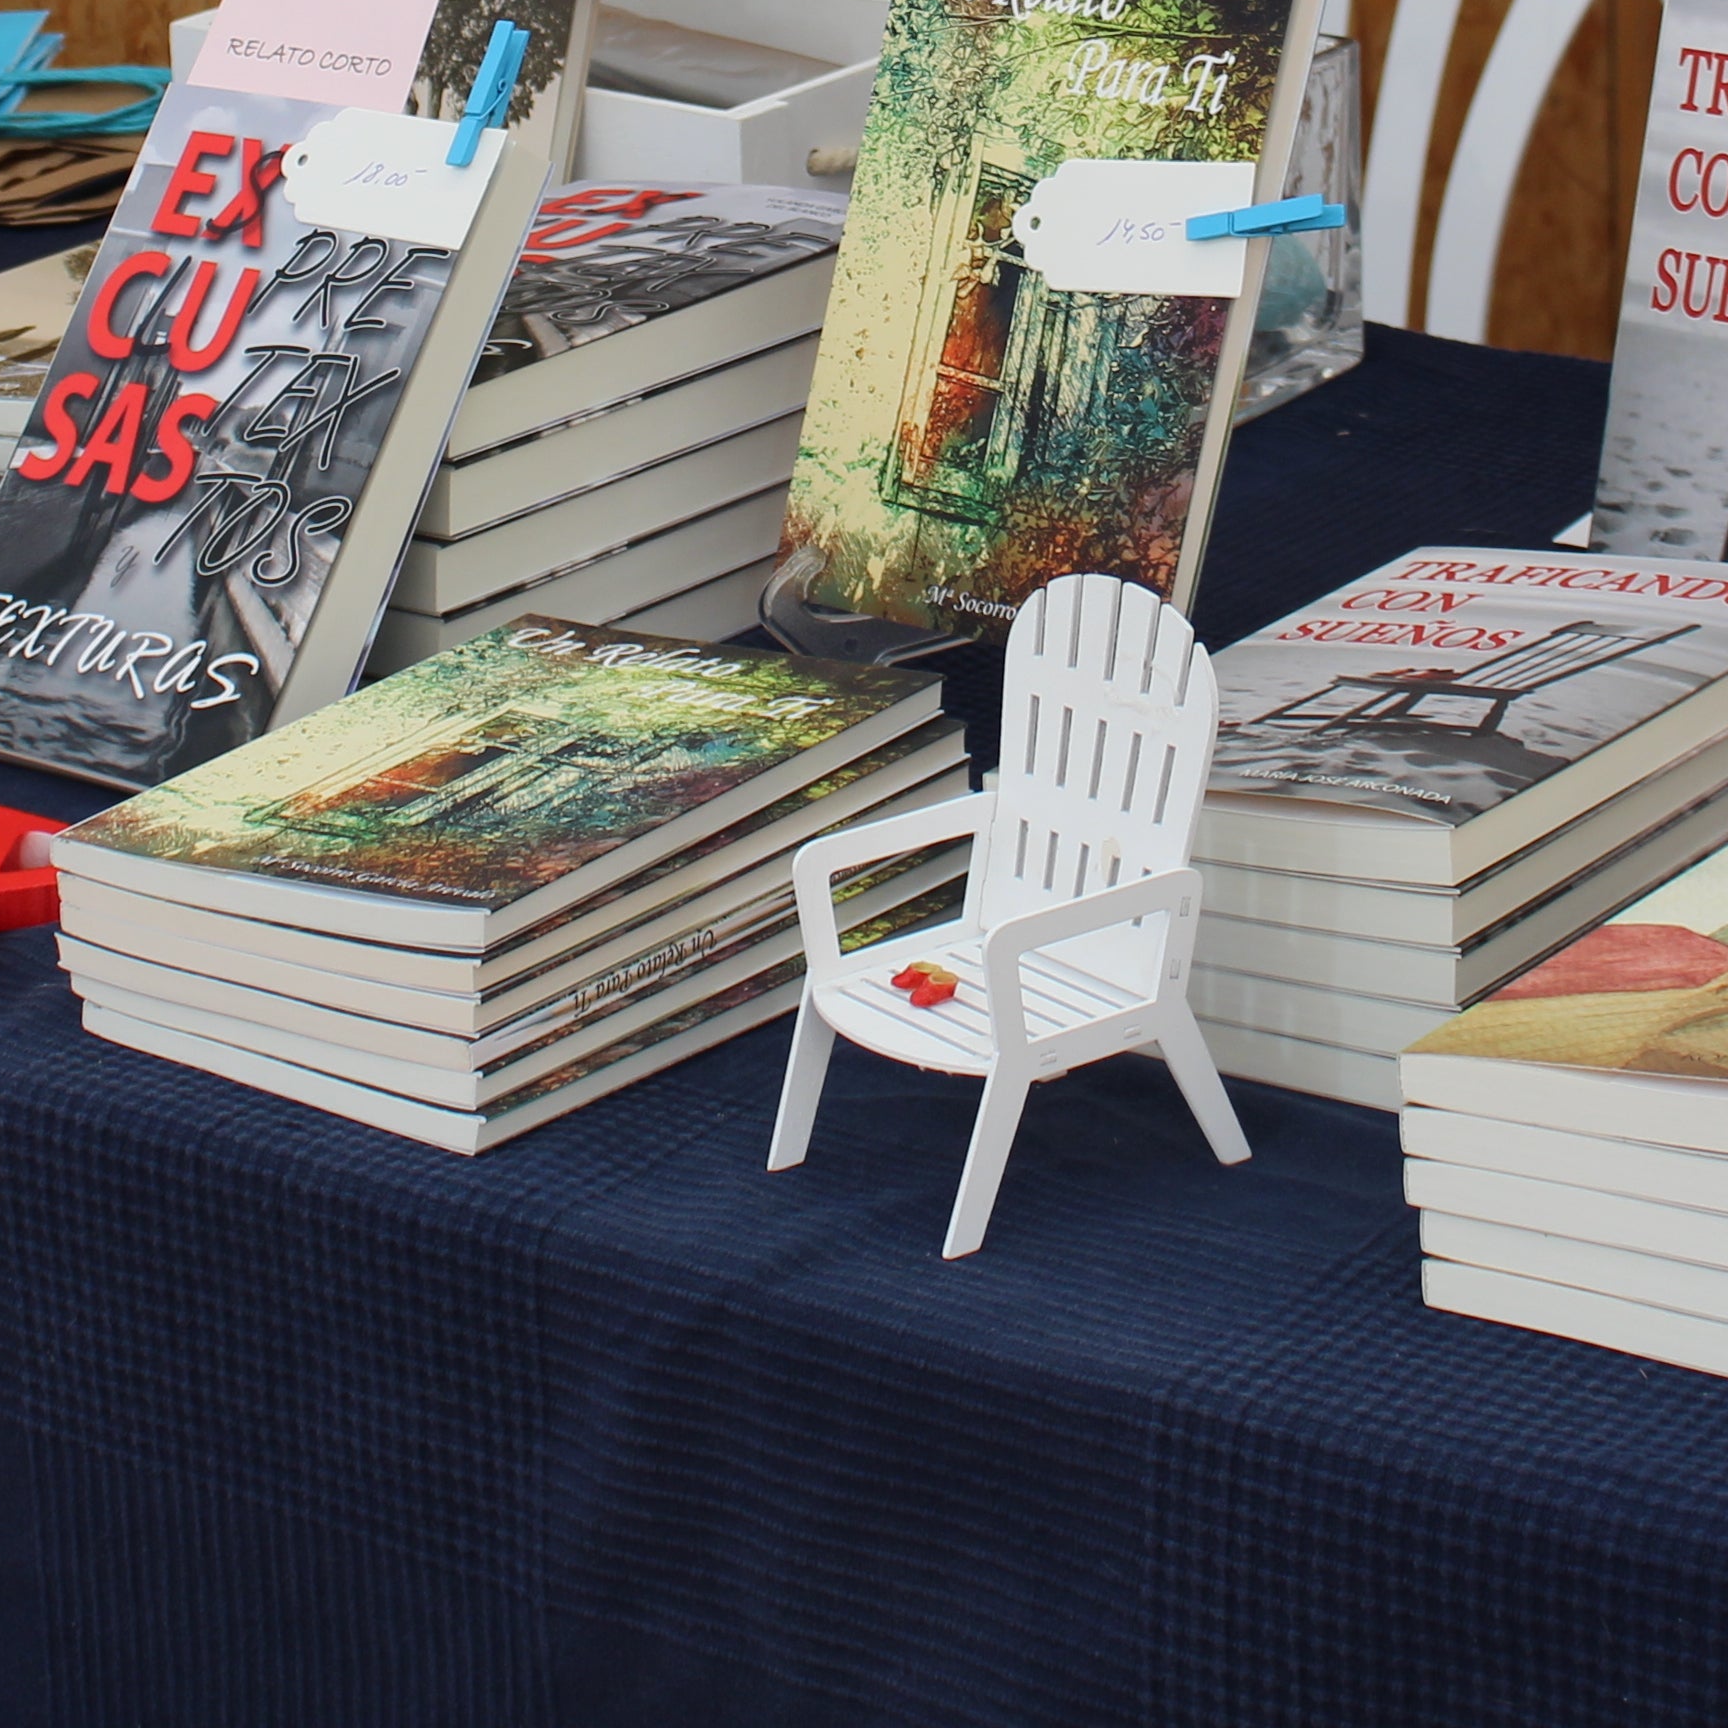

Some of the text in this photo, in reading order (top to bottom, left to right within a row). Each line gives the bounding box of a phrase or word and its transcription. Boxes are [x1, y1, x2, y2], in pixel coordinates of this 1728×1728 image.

[226, 36, 393, 78] RELATO CORTO
[1064, 36, 1238, 119] Para Ti
[150, 129, 293, 249] EX
[86, 248, 262, 374] CU
[246, 226, 452, 331] PRE
[17, 370, 220, 505] SAS
[201, 343, 402, 471] TEX
[152, 471, 354, 588] TOS
[953, 590, 1018, 621] Socorro
[1274, 618, 1526, 654] SUEÑOS
[1339, 588, 1484, 616] CON
[507, 626, 743, 677] Un Relato
[1345, 778, 1453, 806] ARCONADA
